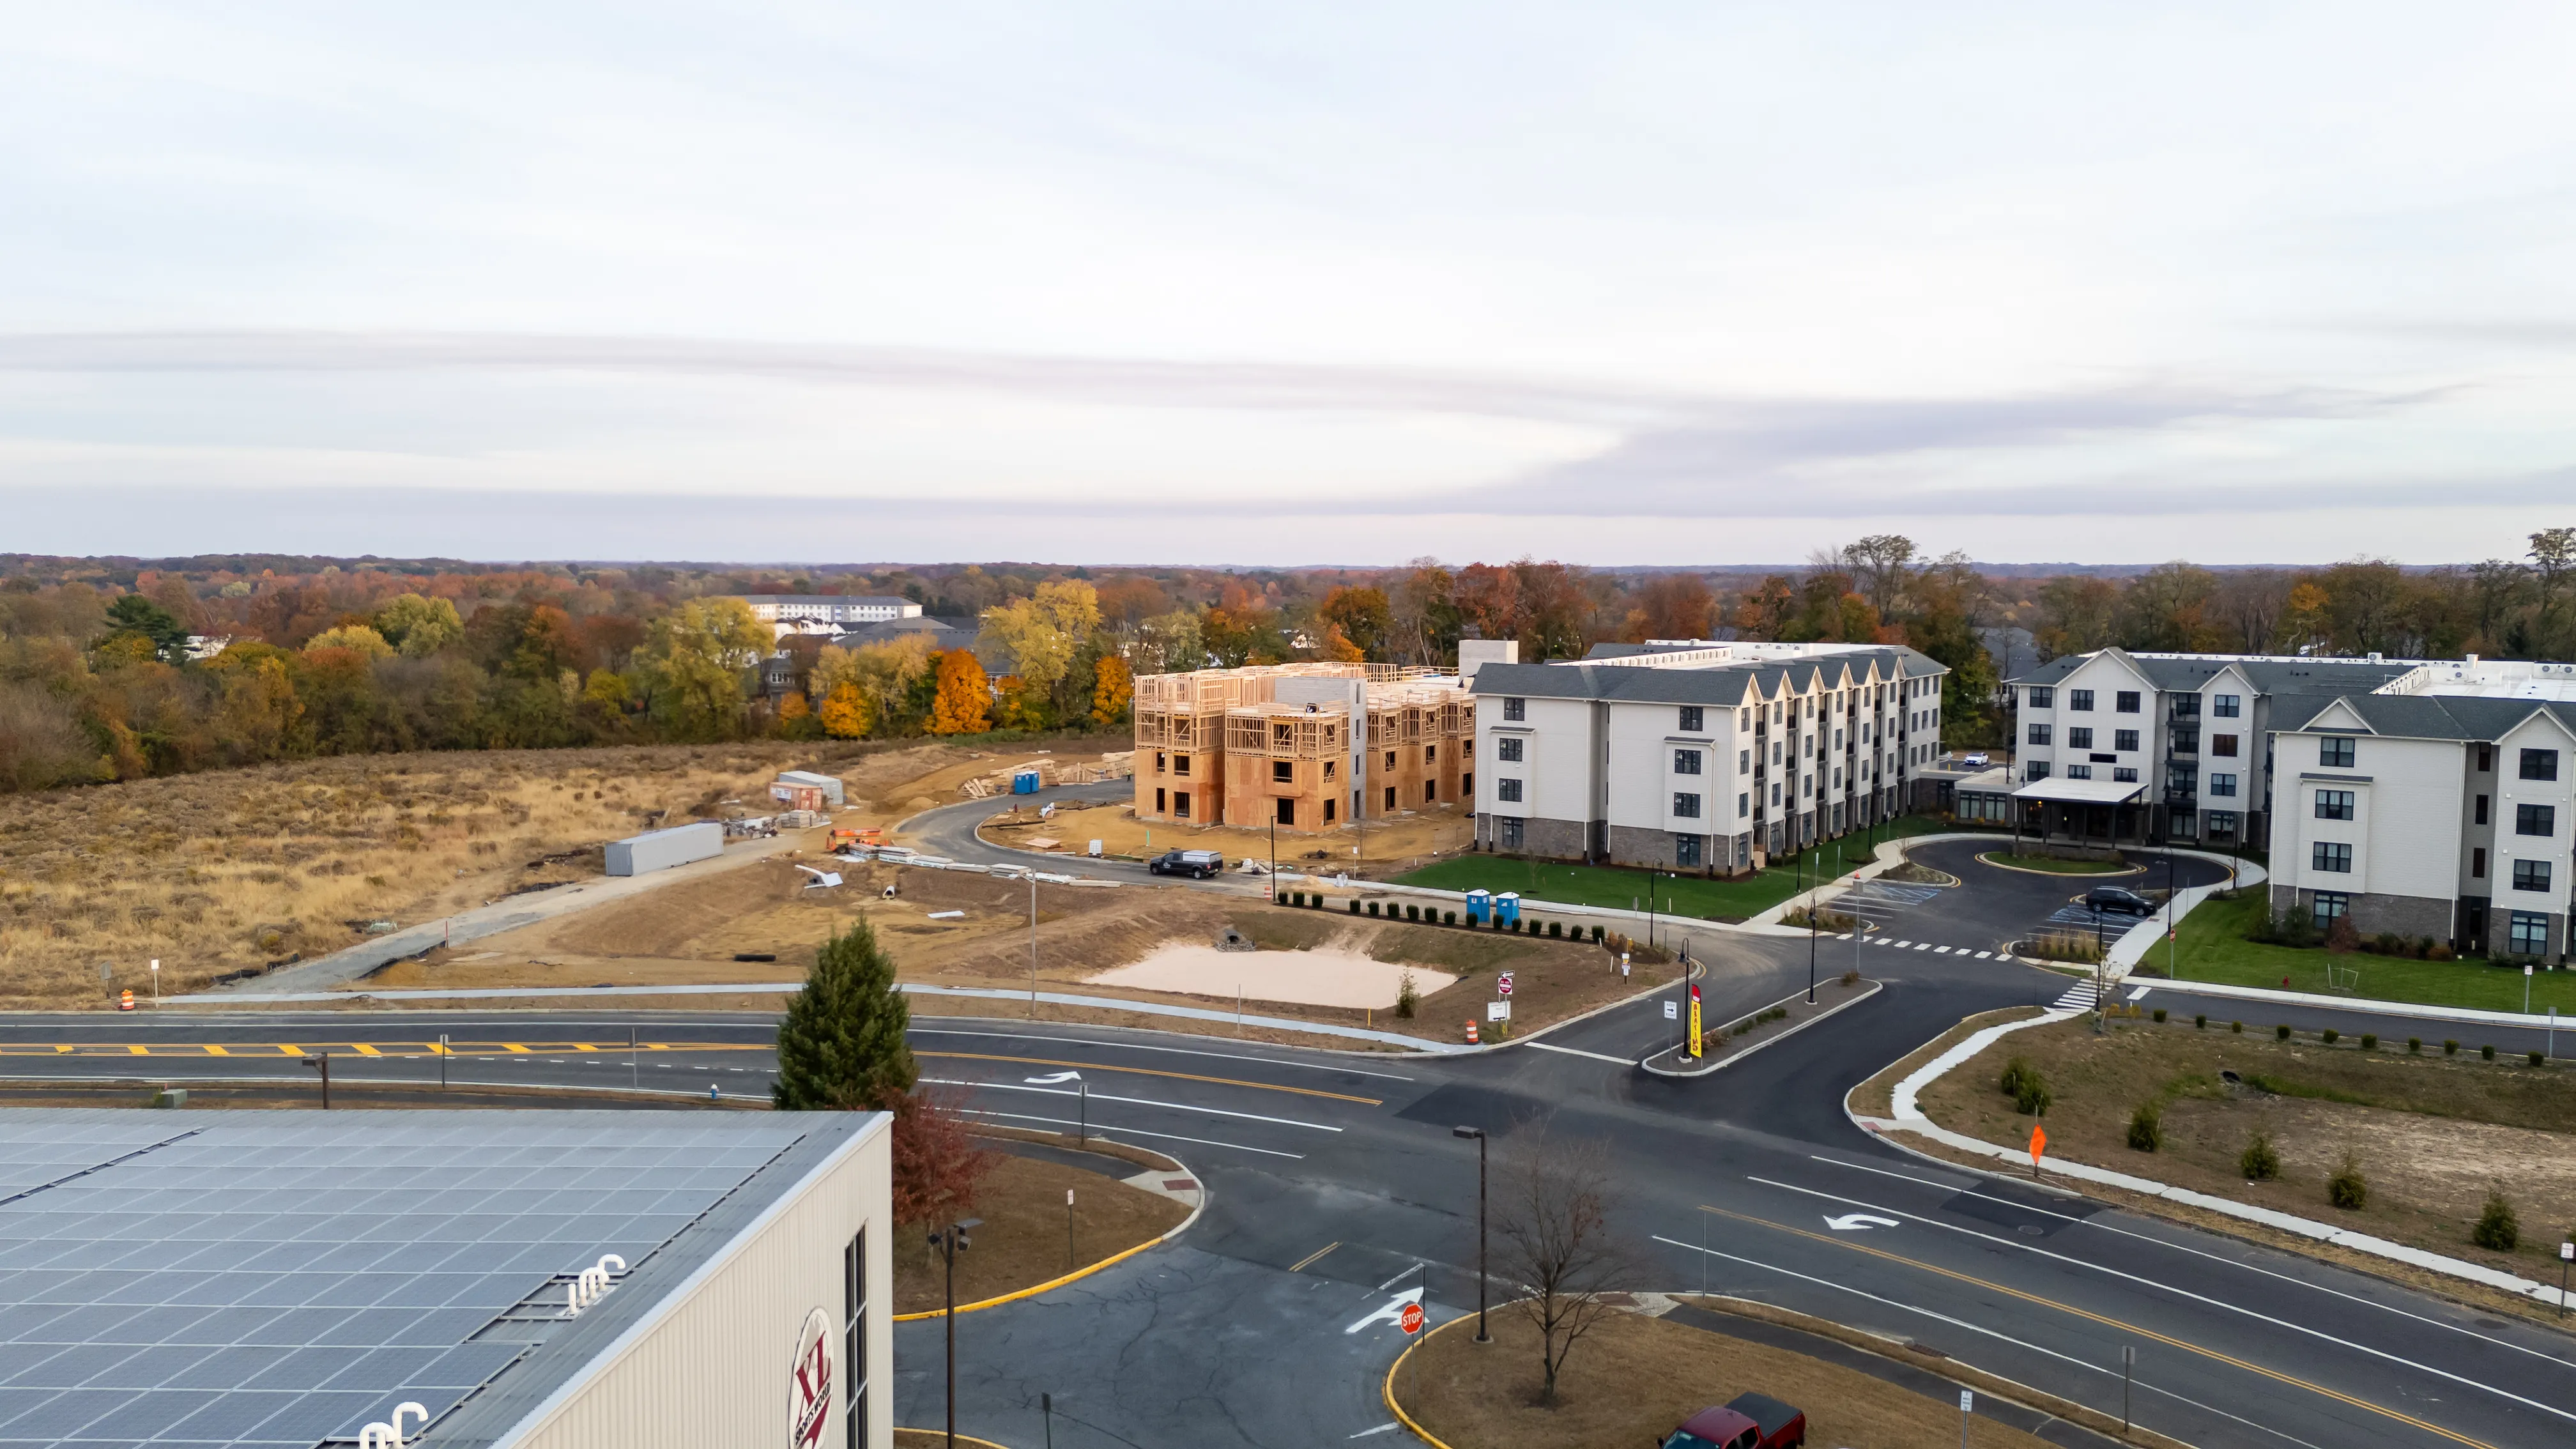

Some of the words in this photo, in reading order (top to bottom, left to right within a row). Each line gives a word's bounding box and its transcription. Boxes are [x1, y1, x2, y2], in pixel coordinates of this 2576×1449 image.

[1403, 1311, 1422, 1327] STOP
[796, 1330, 830, 1429] XL
[795, 1407, 813, 1446] SPORTS
[815, 1382, 830, 1414] WORLD
